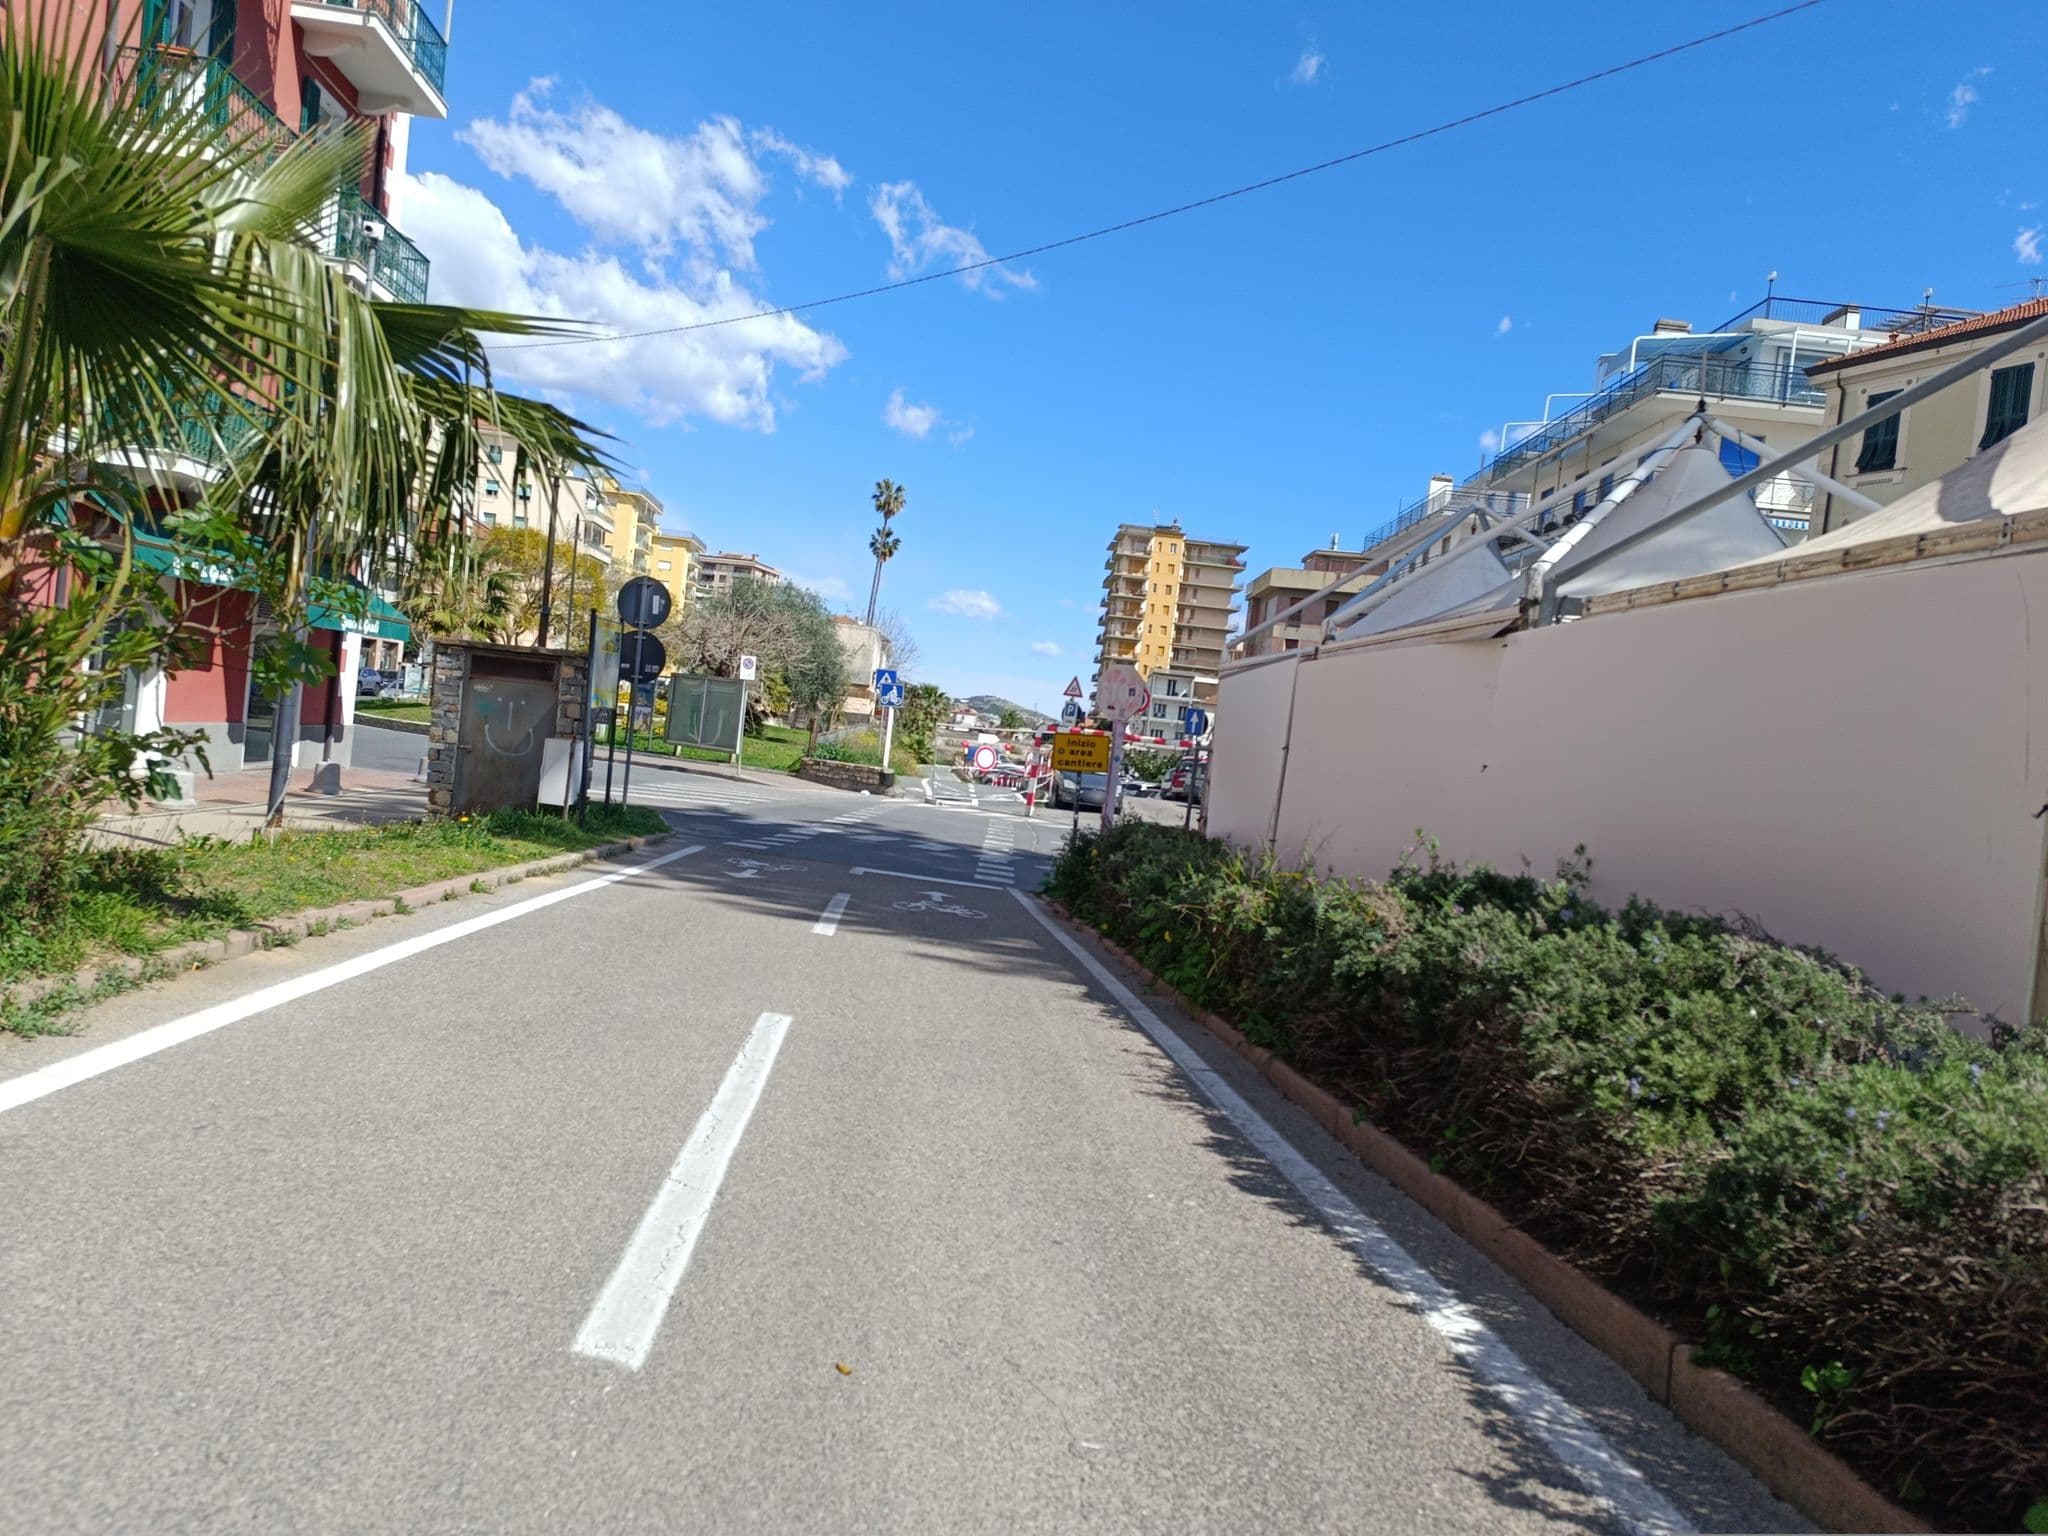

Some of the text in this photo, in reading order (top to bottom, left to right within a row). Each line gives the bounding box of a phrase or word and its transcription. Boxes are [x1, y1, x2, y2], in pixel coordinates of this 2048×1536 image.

[1067, 704, 1074, 715] P
[1067, 738, 1096, 748] inizio
[1069, 749, 1093, 757] area
[1057, 759, 1103, 768] cantiere
